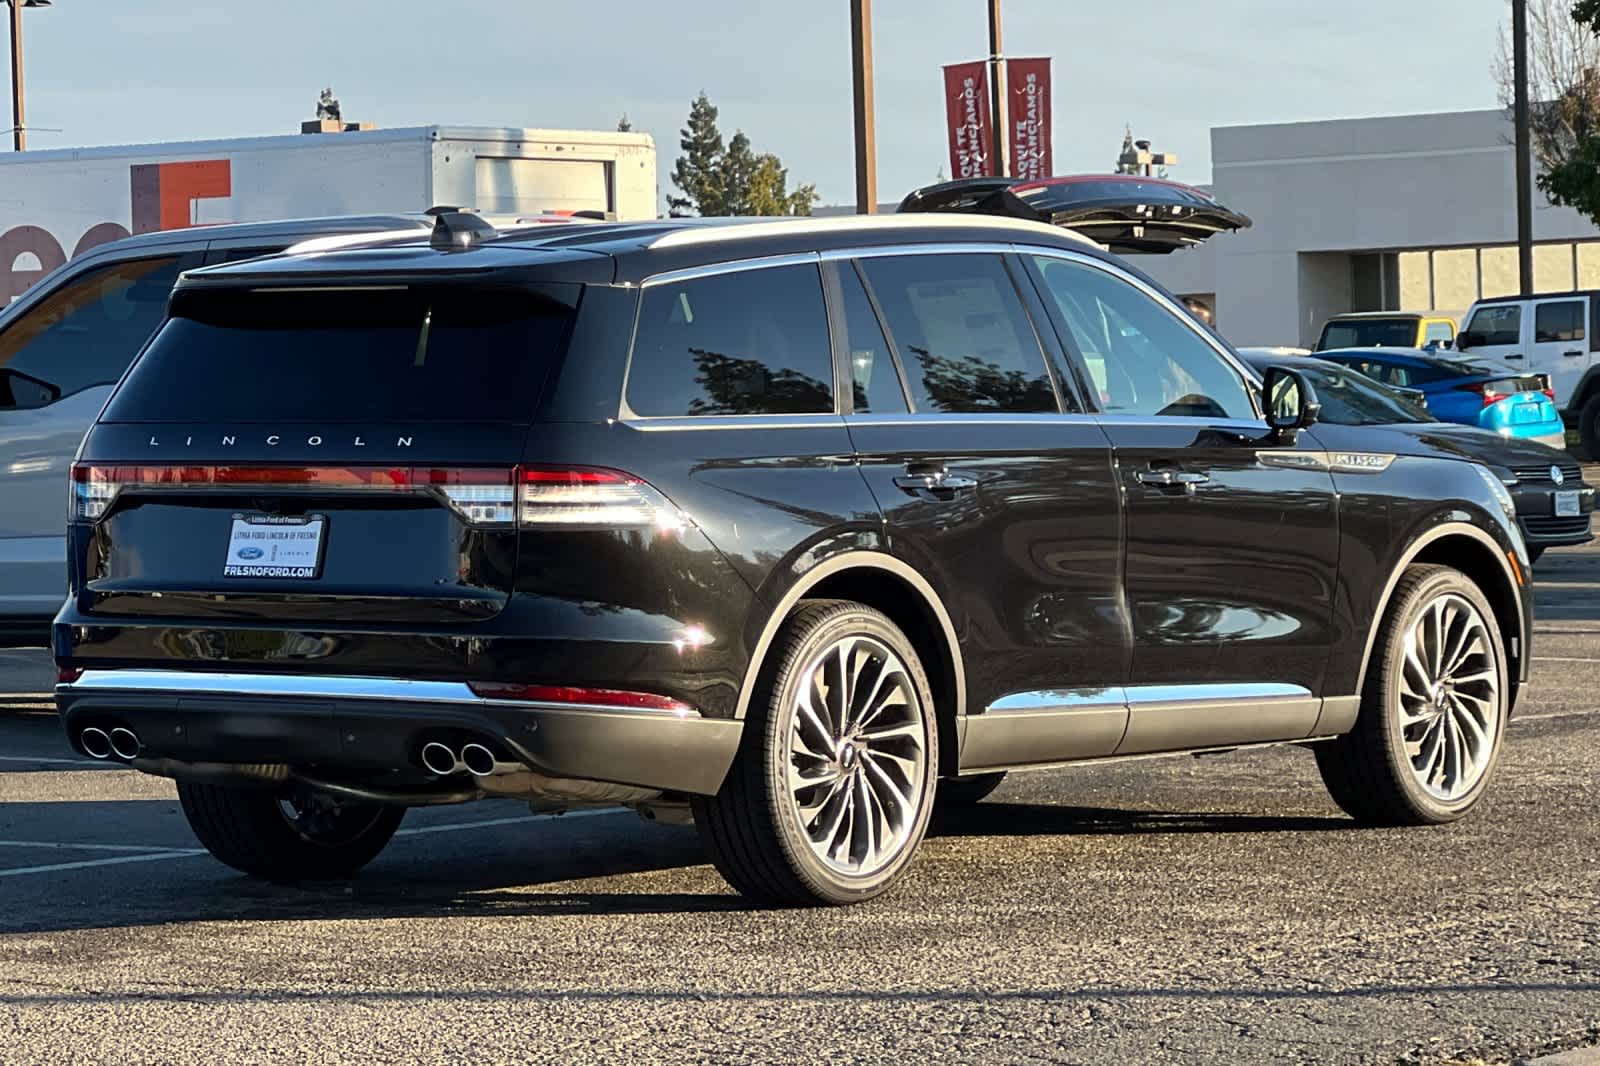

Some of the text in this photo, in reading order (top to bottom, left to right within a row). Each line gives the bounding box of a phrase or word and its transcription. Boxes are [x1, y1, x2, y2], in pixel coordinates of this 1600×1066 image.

[964, 78, 982, 178] INANCIAMOS
[1016, 121, 1026, 140] TE
[956, 127, 972, 178] QUÍ TE
[150, 435, 413, 447] LINCOLN
[234, 531, 250, 539] LITHIA
[252, 531, 265, 540] FORD
[266, 531, 288, 540] LINCOLN
[297, 531, 317, 540] FRESNO
[224, 566, 313, 577] FRESNOFORD.COM
